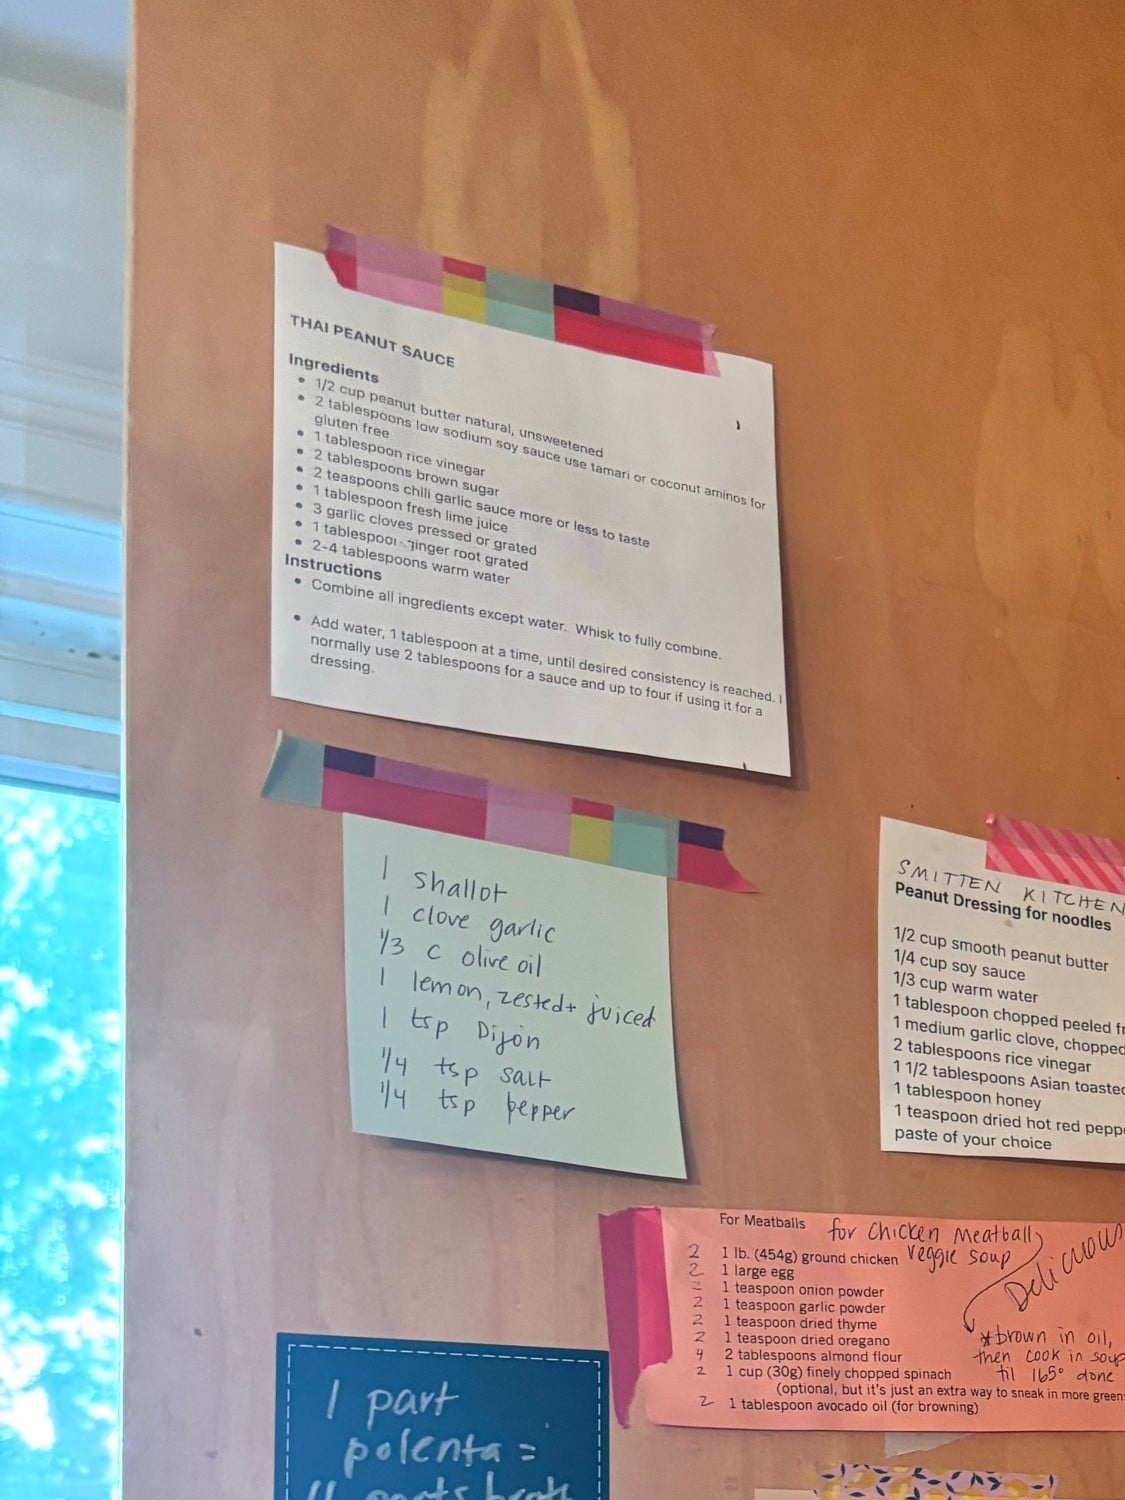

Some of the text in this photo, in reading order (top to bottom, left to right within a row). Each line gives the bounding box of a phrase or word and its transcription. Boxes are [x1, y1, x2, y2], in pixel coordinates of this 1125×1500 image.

[289, 314, 456, 368] THAI PEANUT SAUCE
[288, 352, 380, 384] Ingredients
[315, 377, 604, 458] 1/2 cup peanut butter natural, unsweetened
[313, 448, 500, 499] 2 tablespoons brown sugar
[284, 552, 383, 582] Instructions
[310, 651, 375, 675] dressing.
[897, 858, 1002, 895] SMITTEN
[413, 906, 470, 929] clove
[489, 917, 556, 943] garlic
[895, 881, 1112, 932] Peanut Dressing for noodles
[380, 928, 405, 955] 1/3
[461, 944, 509, 972] olive
[517, 954, 542, 977] oil
[893, 925, 1109, 973] 1/2 cup smooth peanut butter
[893, 948, 1026, 982] 1/4 cup soy sauce
[719, 1212, 806, 1231] For Meatballs
[828, 1221, 857, 1242] for
[953, 1225, 1036, 1247] Meatball
[968, 1249, 1011, 1271] soup
[735, 1298, 795, 1316] teaspoon
[800, 1300, 835, 1316] garlic
[839, 1301, 885, 1316] powder
[1076, 1368, 1115, 1383] done
[326, 1379, 460, 1431] 1 part
[343, 1427, 503, 1480] polenta
